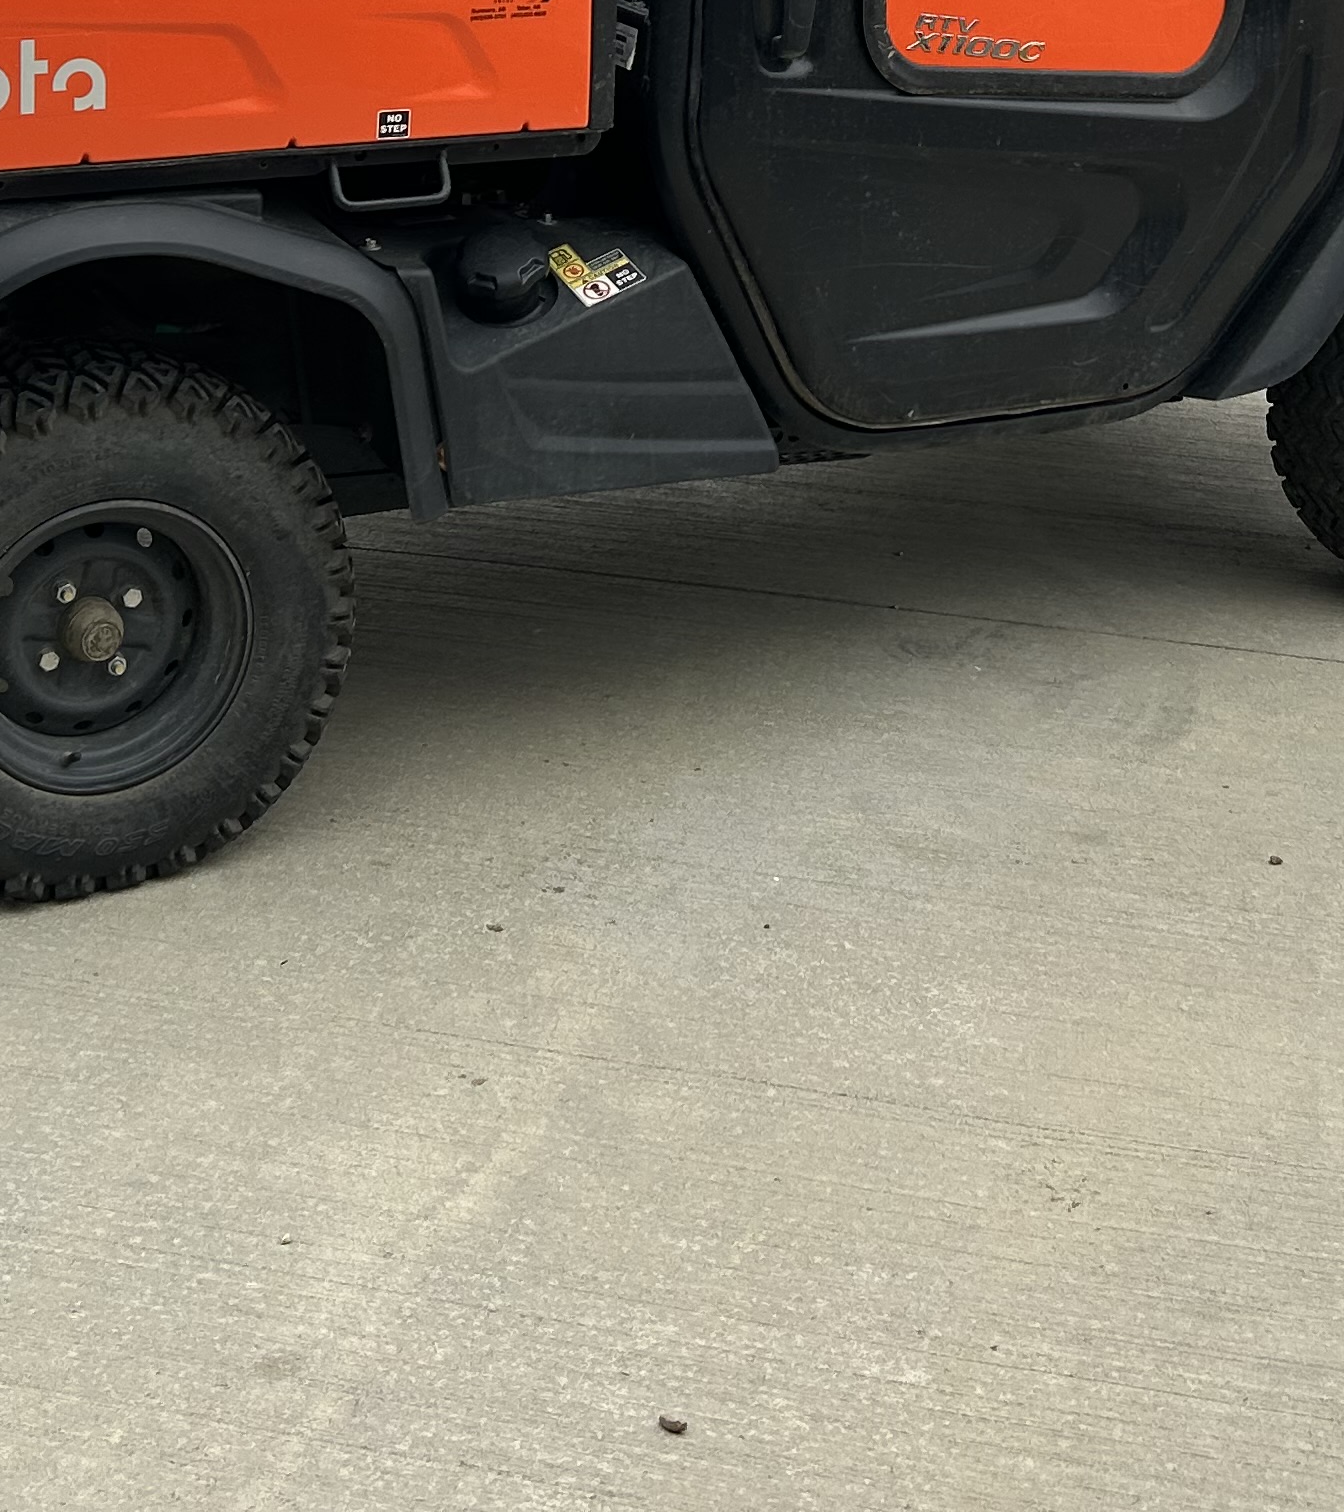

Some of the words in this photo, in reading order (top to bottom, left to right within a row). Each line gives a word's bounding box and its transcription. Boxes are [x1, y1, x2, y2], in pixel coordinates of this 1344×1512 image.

[915, 13, 980, 33] RTV
[906, 30, 1046, 63] X1100C
[386, 113, 403, 123] NO
[379, 123, 408, 134] STEP
[615, 268, 630, 279] NO
[615, 271, 638, 286] STEP
